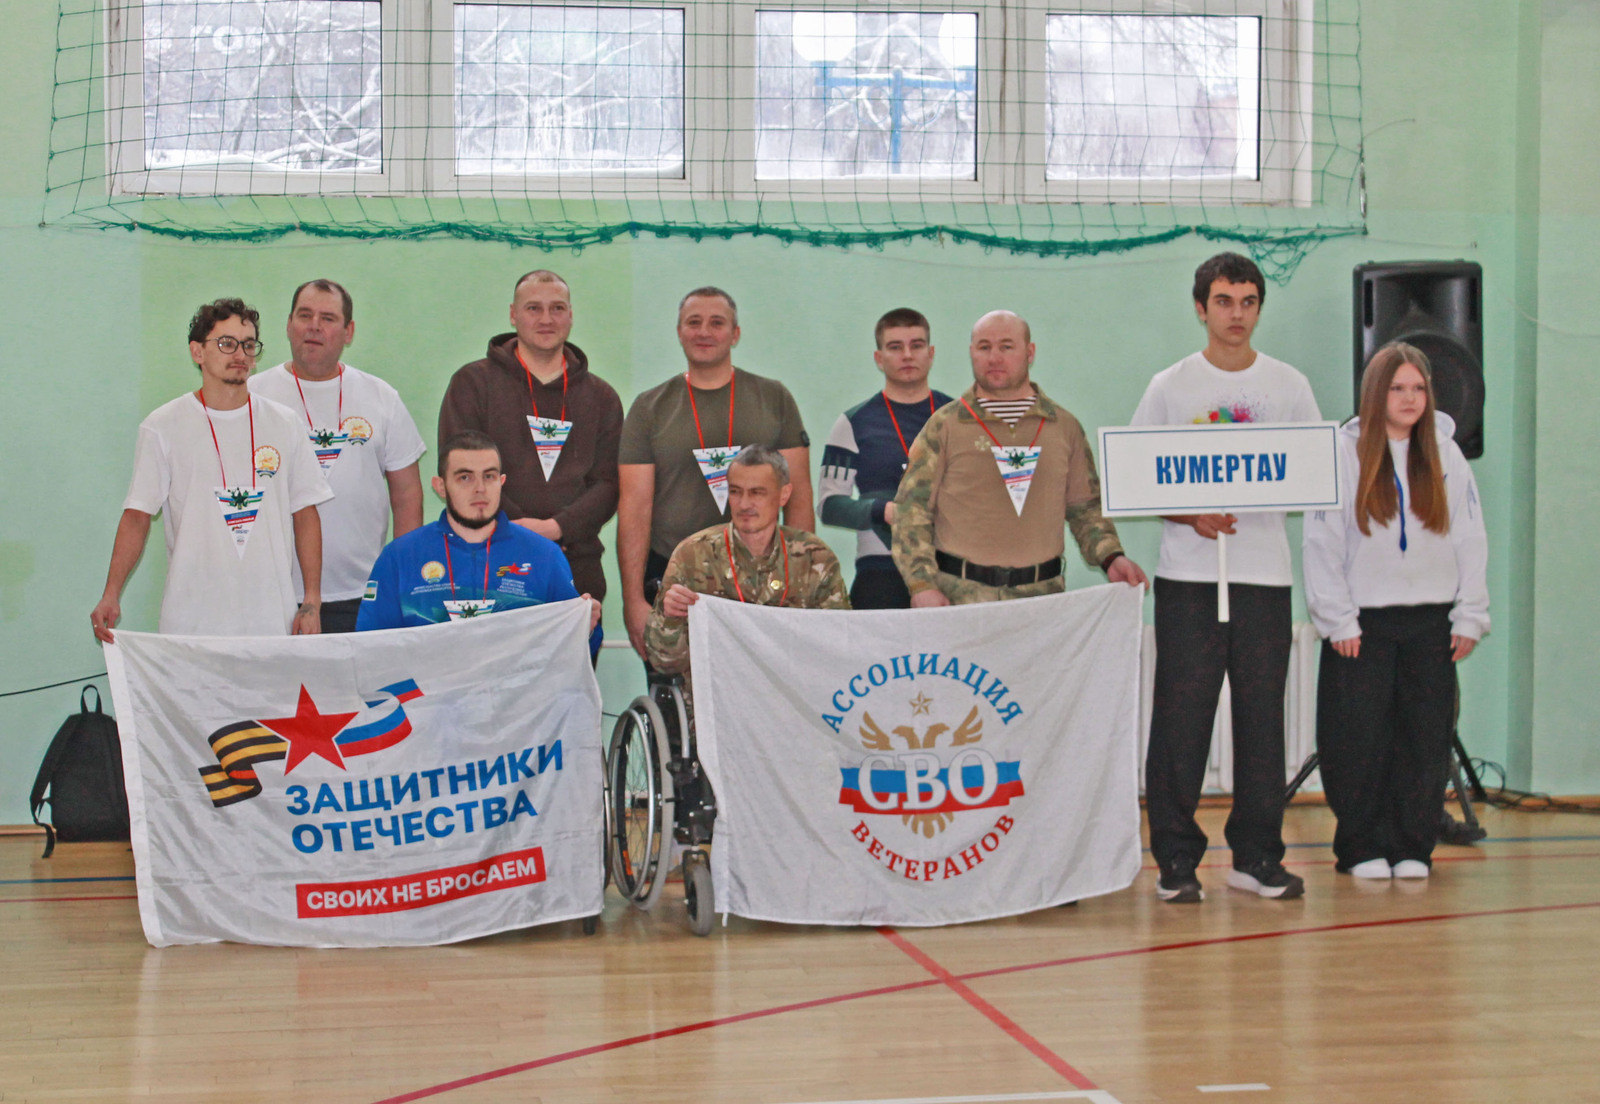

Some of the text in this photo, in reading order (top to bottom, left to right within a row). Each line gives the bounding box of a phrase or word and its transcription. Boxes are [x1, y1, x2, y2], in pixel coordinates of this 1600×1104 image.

[1156, 453, 1287, 484] КУМЕРТАУ
[821, 653, 1023, 734] АССОЦИАЦИЯ
[285, 739, 563, 816] ЗАЩИТНИКИ
[858, 749, 999, 811] СВО
[291, 790, 538, 854] ОТЕЧЕСТВА
[851, 815, 1015, 881] ВЕТЕРАНОВ
[306, 857, 536, 910] СВОИХ НЕ БРОСАЕМ
